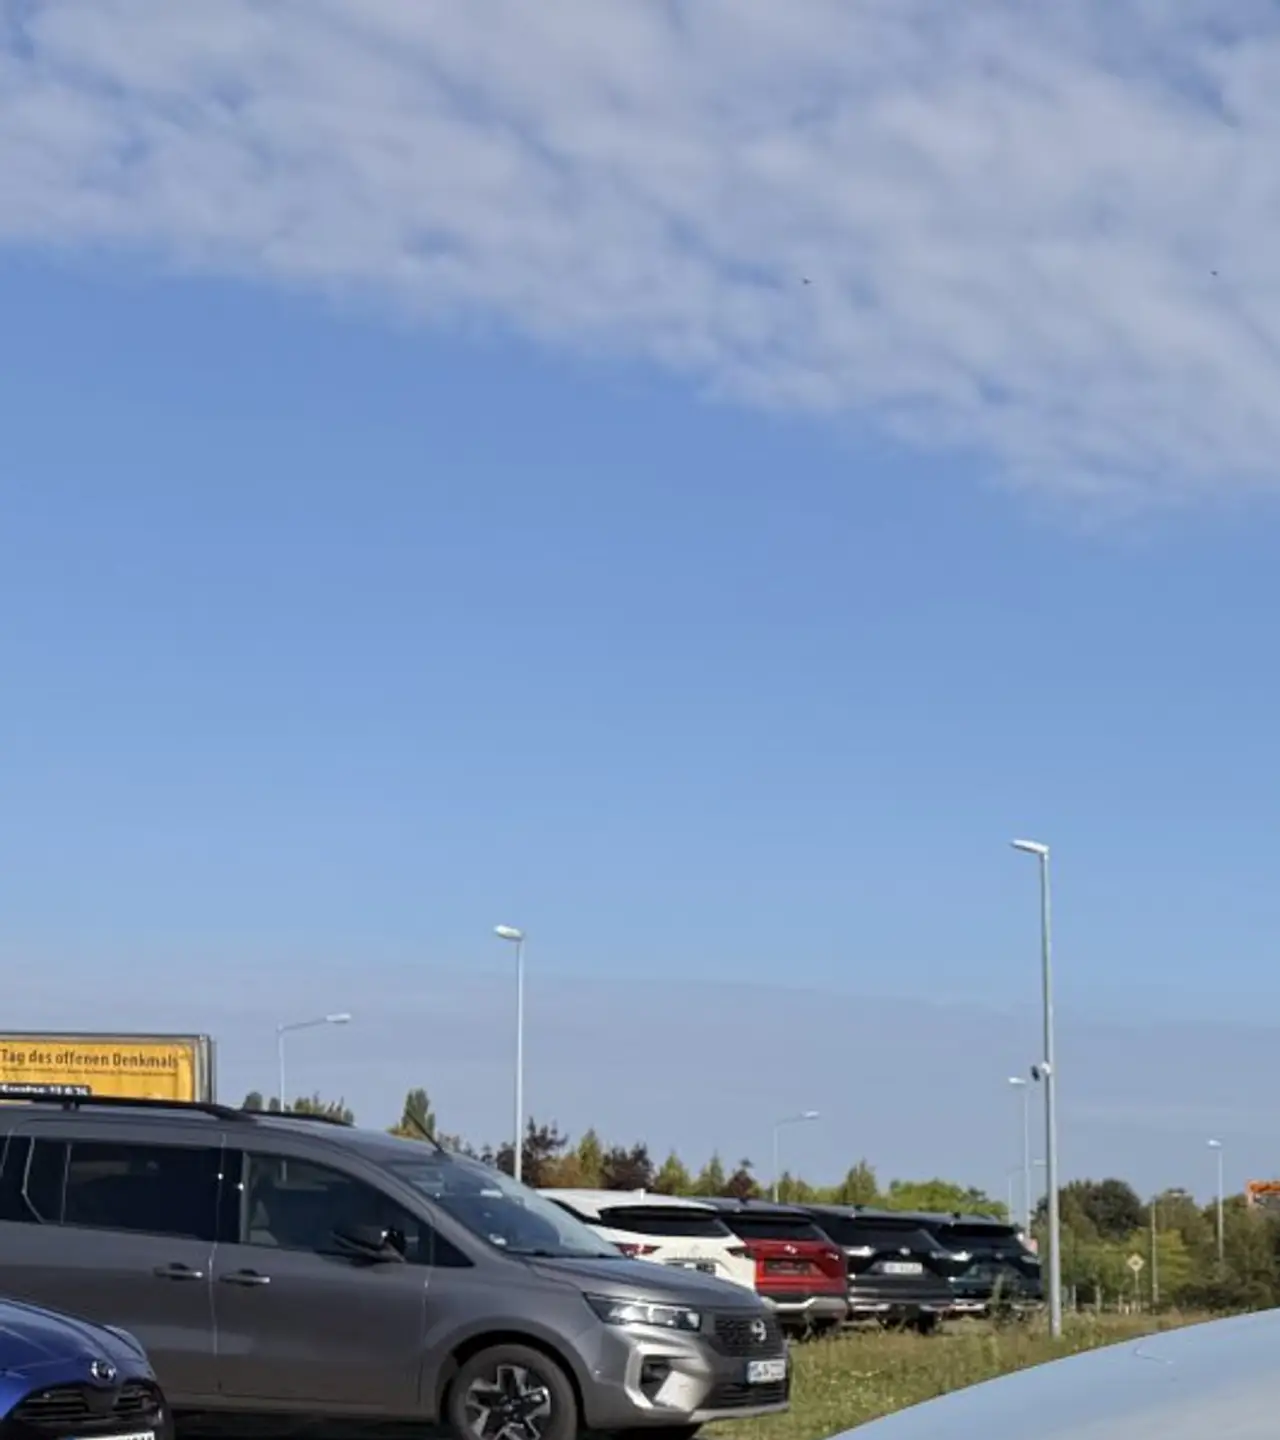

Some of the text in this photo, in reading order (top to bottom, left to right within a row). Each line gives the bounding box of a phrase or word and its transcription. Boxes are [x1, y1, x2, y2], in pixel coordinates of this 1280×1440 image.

[2, 1049, 178, 1068] Tag des offenen Denkmals
